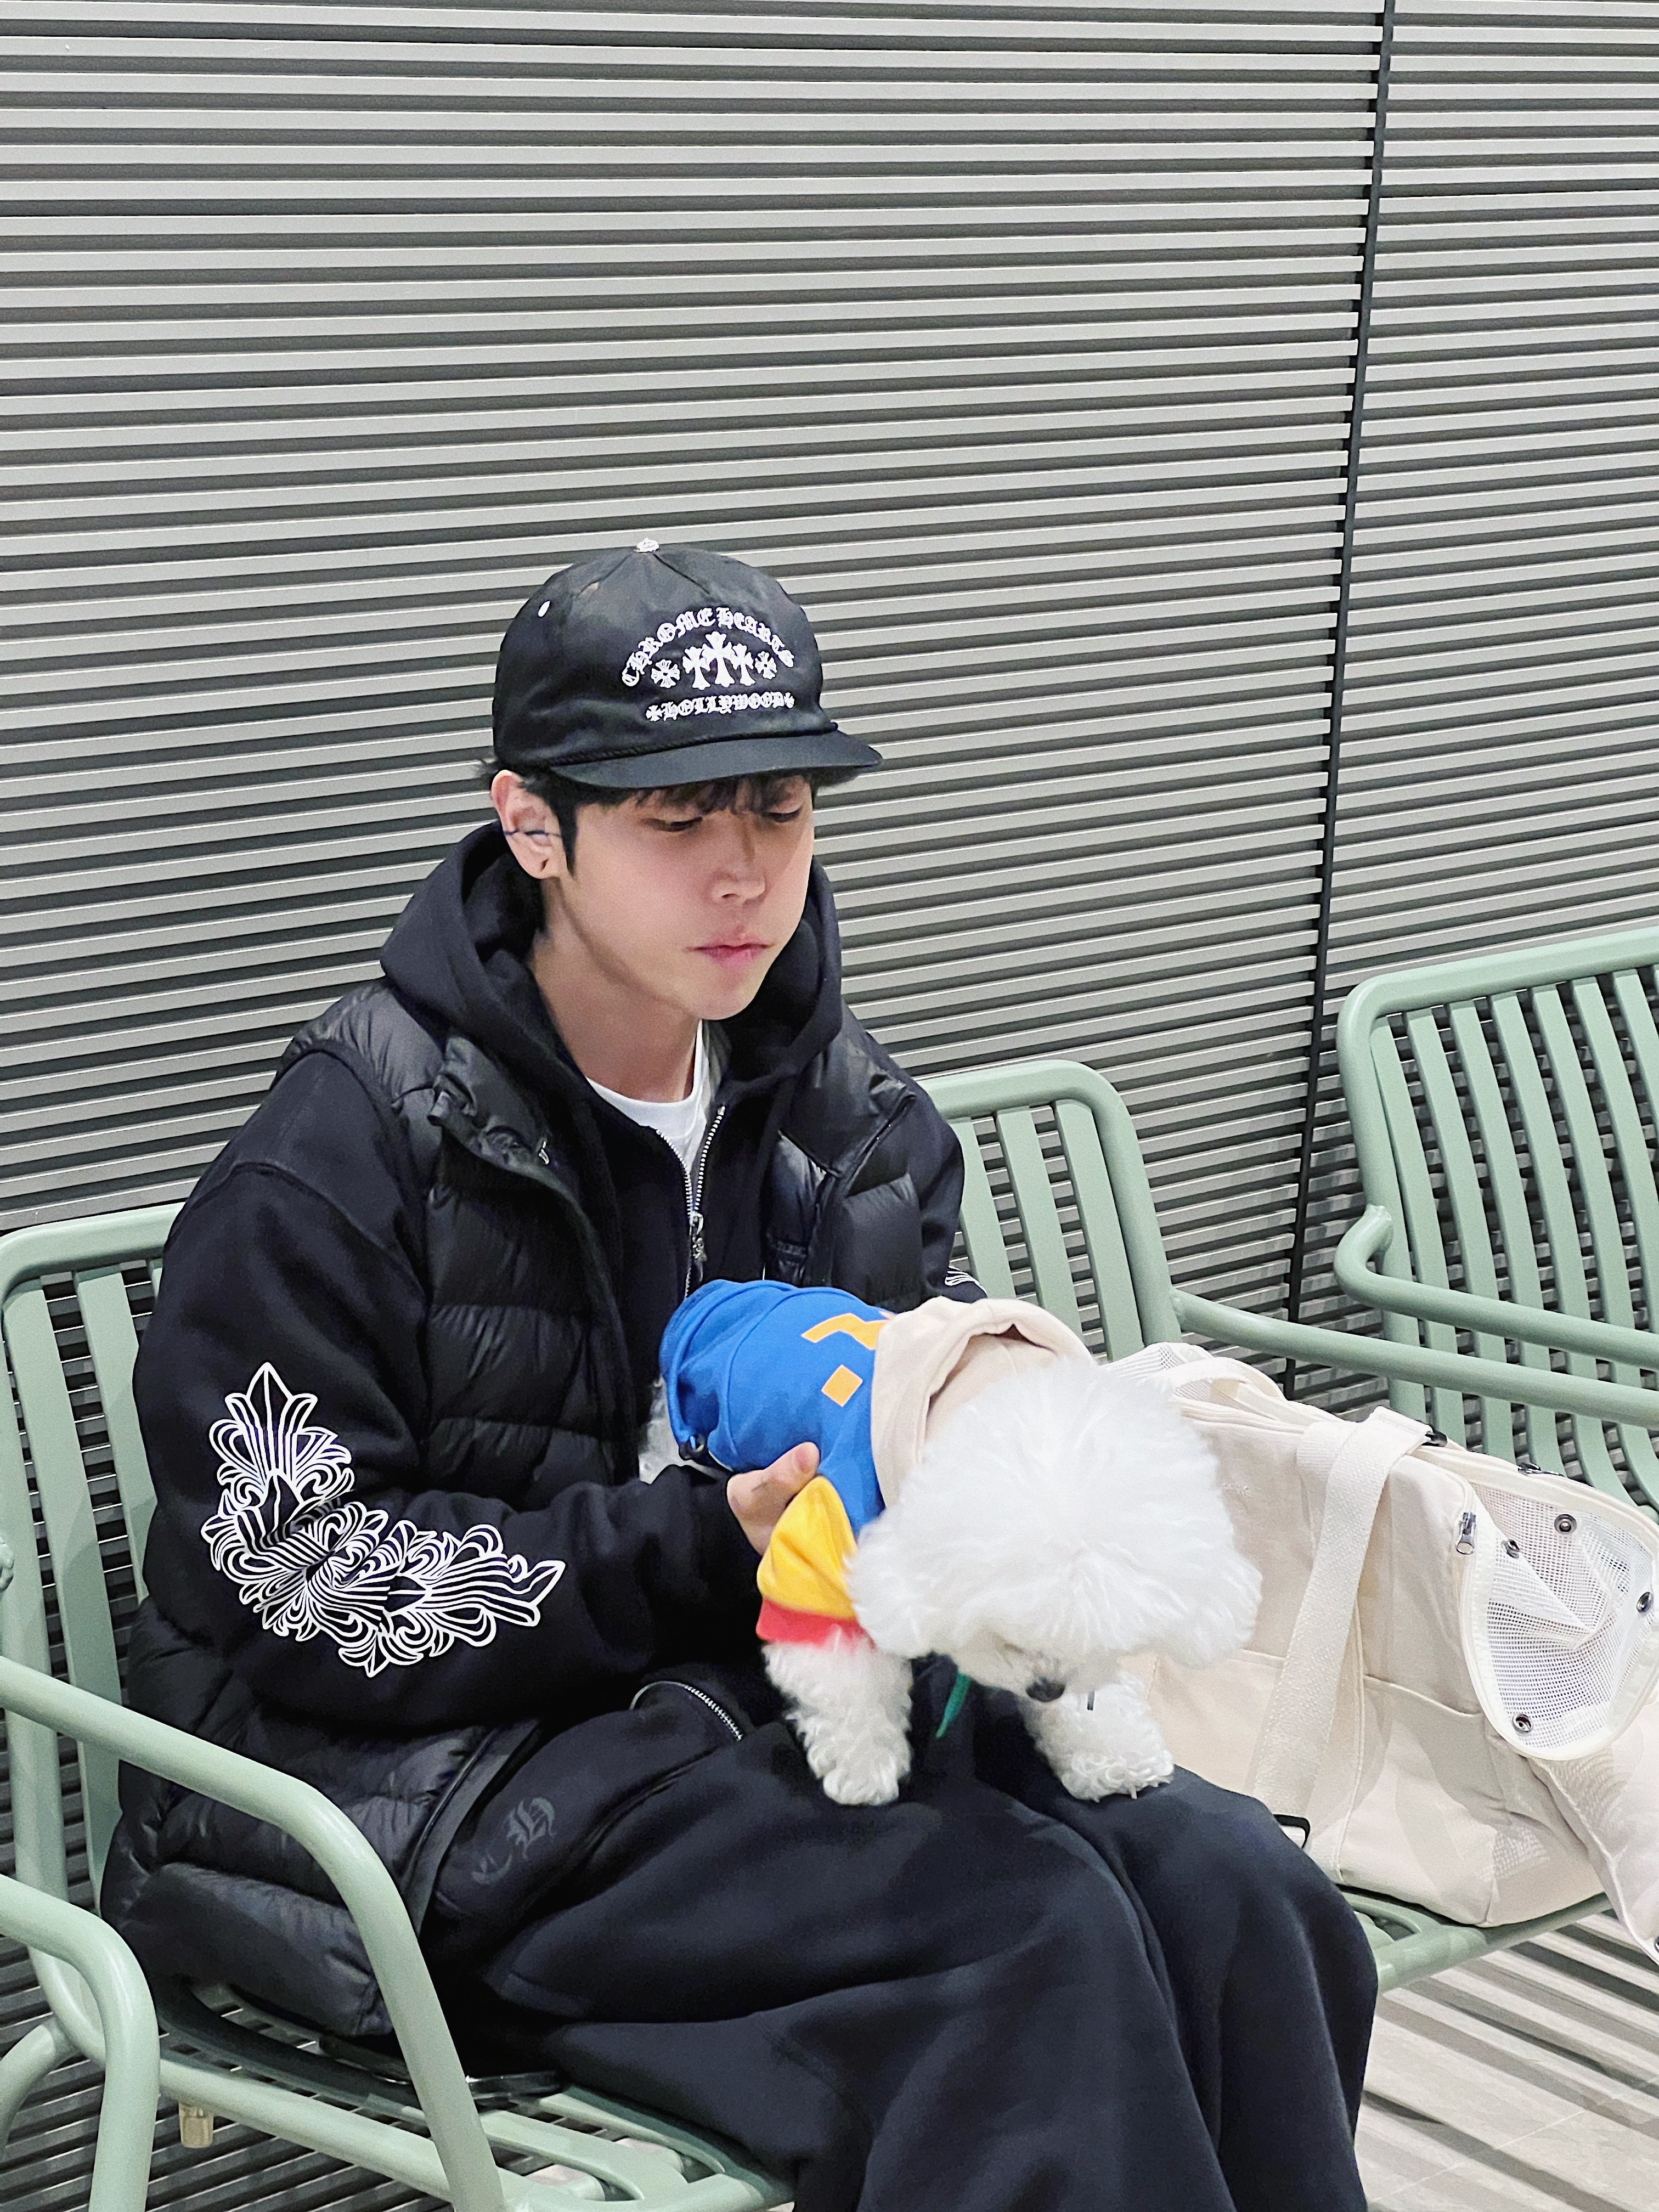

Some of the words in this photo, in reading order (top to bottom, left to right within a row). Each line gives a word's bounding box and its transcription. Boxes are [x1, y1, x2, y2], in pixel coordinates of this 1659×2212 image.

[622, 607, 715, 686] CHROME
[716, 607, 794, 668] HEARTS
[661, 691, 785, 720] HOLLYWOOD
